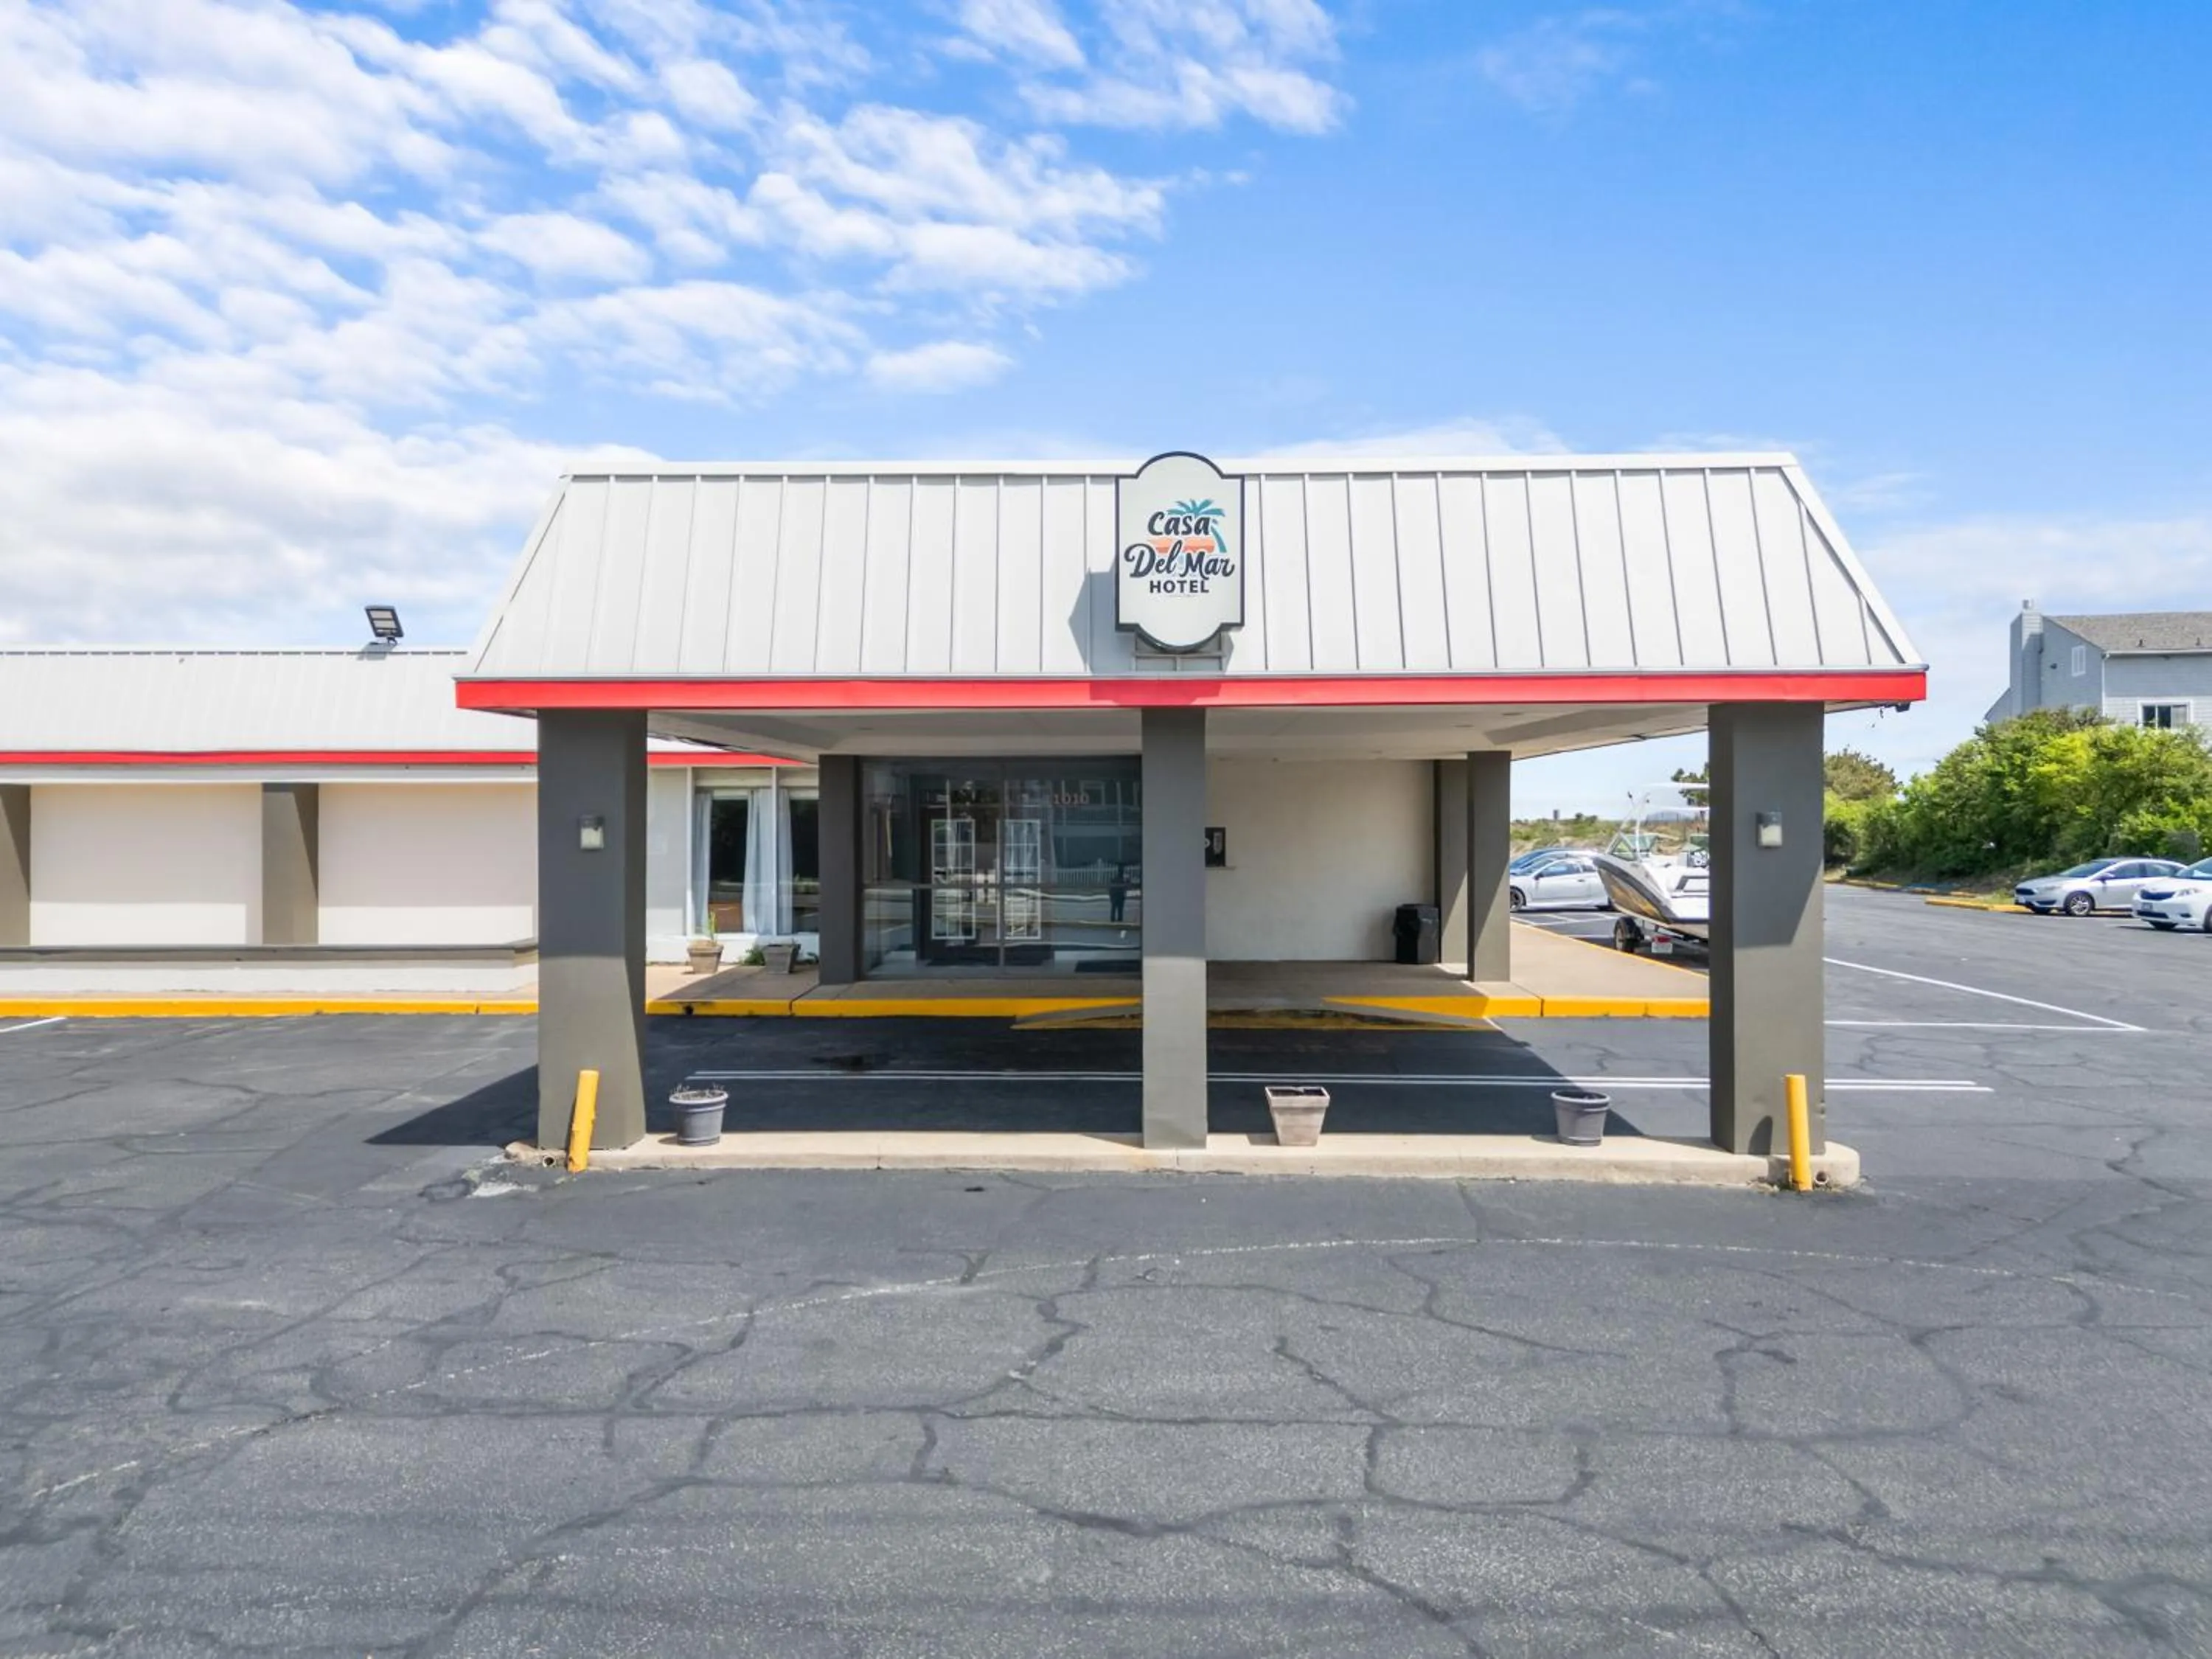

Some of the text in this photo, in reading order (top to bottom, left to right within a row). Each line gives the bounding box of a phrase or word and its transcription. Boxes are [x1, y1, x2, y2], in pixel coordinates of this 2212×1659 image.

[1147, 512, 1210, 535] Casa
[1124, 540, 1235, 580] Del Mar
[1150, 580, 1209, 594] HOTEL
